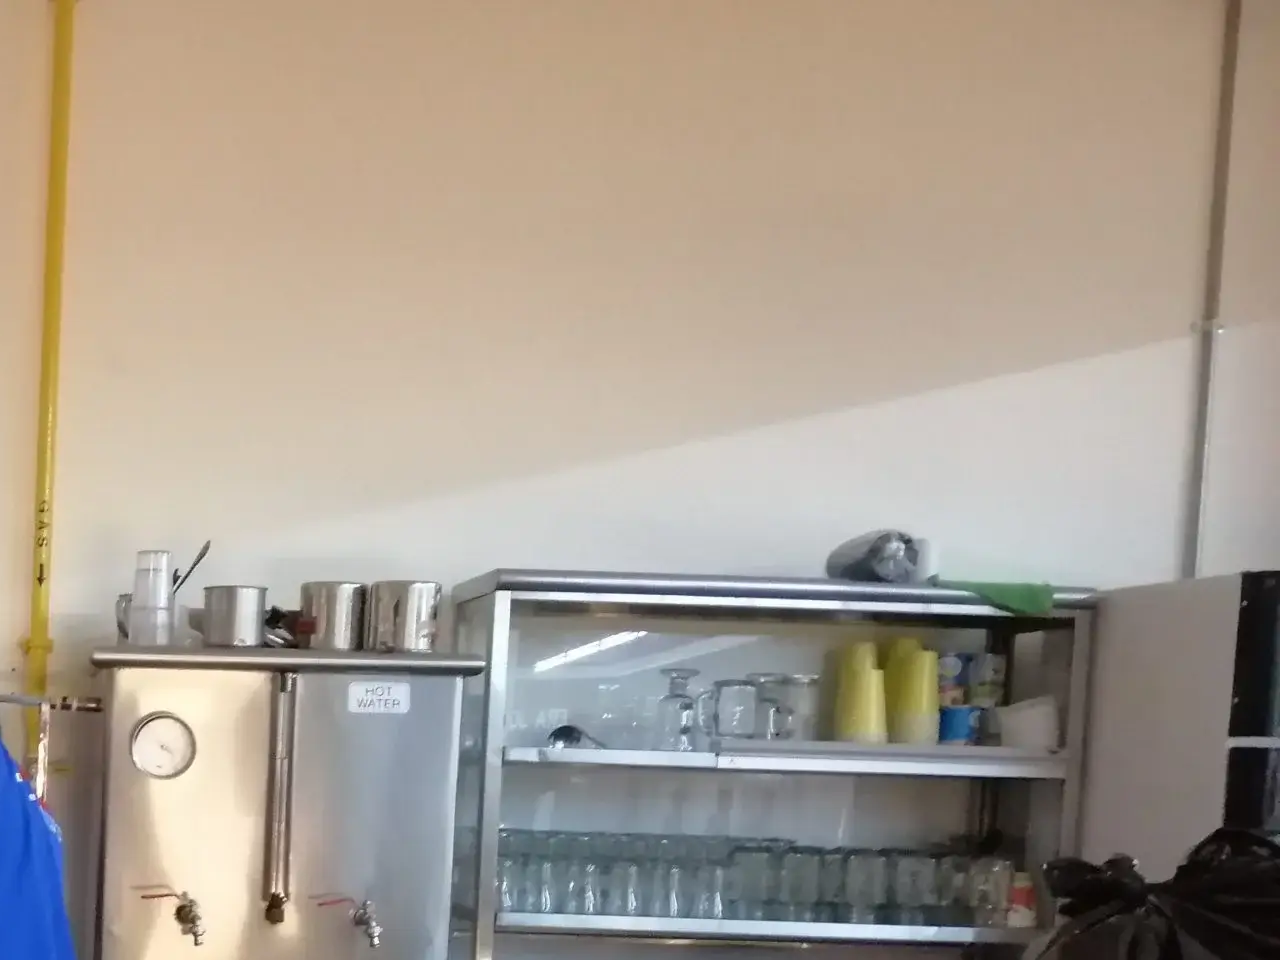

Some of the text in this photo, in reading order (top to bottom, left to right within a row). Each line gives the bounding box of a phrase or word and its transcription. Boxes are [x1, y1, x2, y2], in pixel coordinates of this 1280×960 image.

[36, 499, 50, 548] GAS
[365, 686, 393, 697] HOT
[356, 698, 401, 709] WATER
